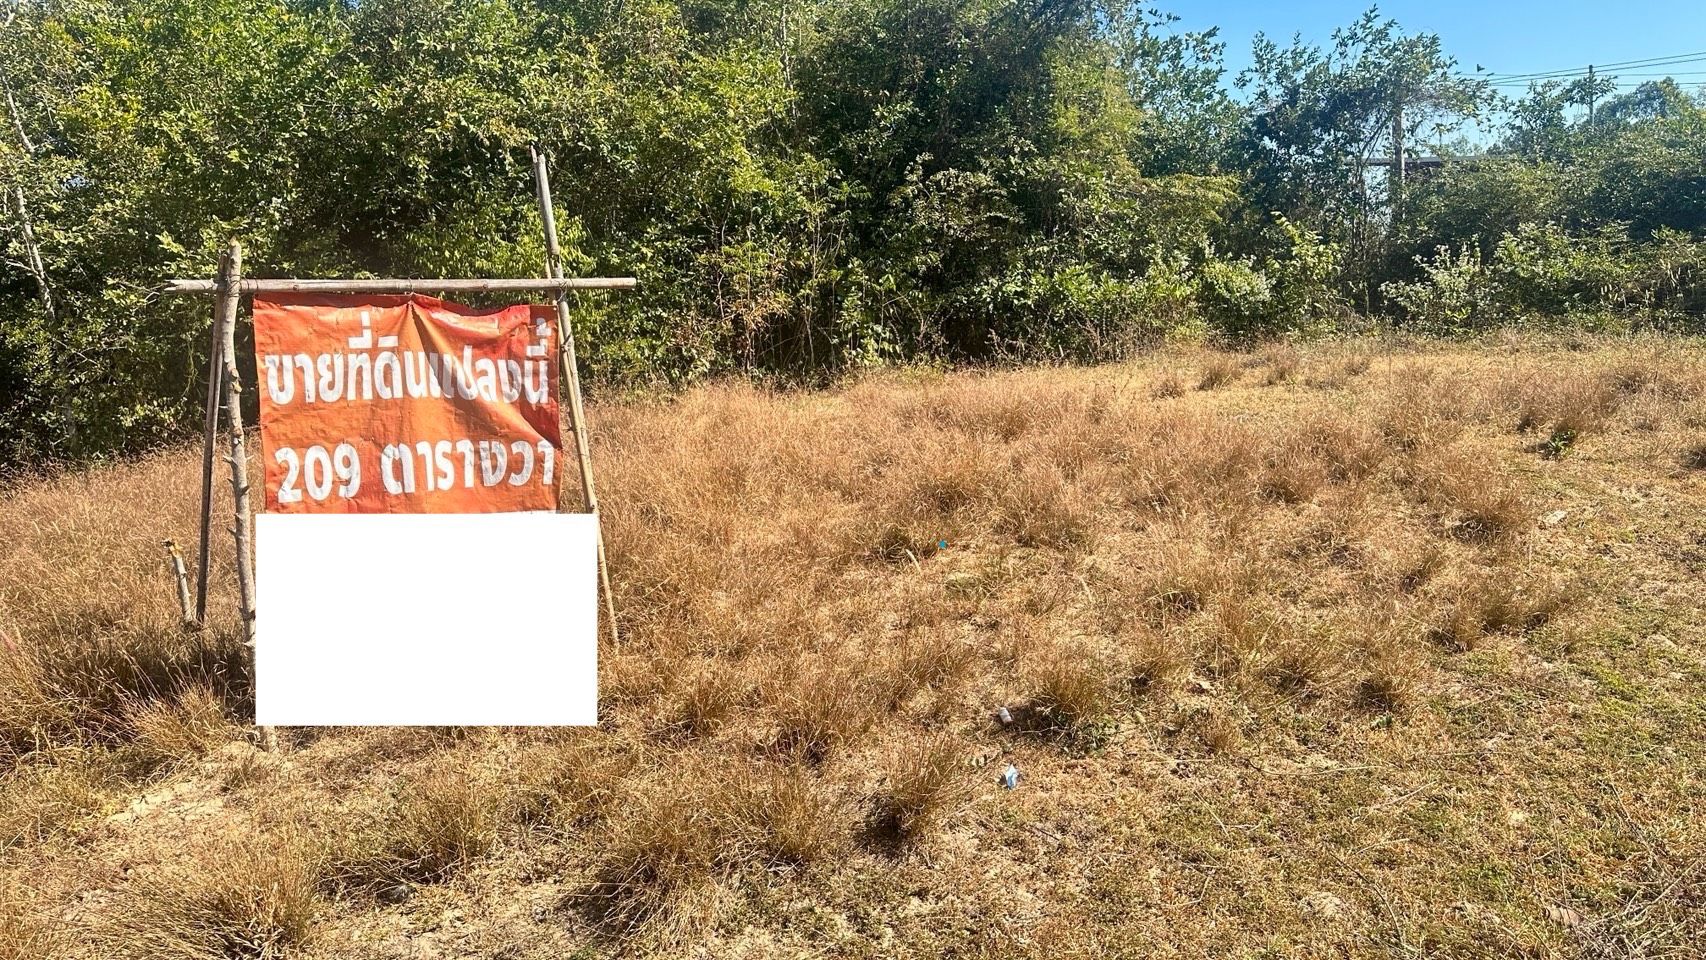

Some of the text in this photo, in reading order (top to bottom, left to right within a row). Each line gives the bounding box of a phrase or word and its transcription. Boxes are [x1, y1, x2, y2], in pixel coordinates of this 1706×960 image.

[265, 311, 551, 404] ขายที่ดินแปลงนี้
[275, 440, 554, 503] 209 ตารางวา
